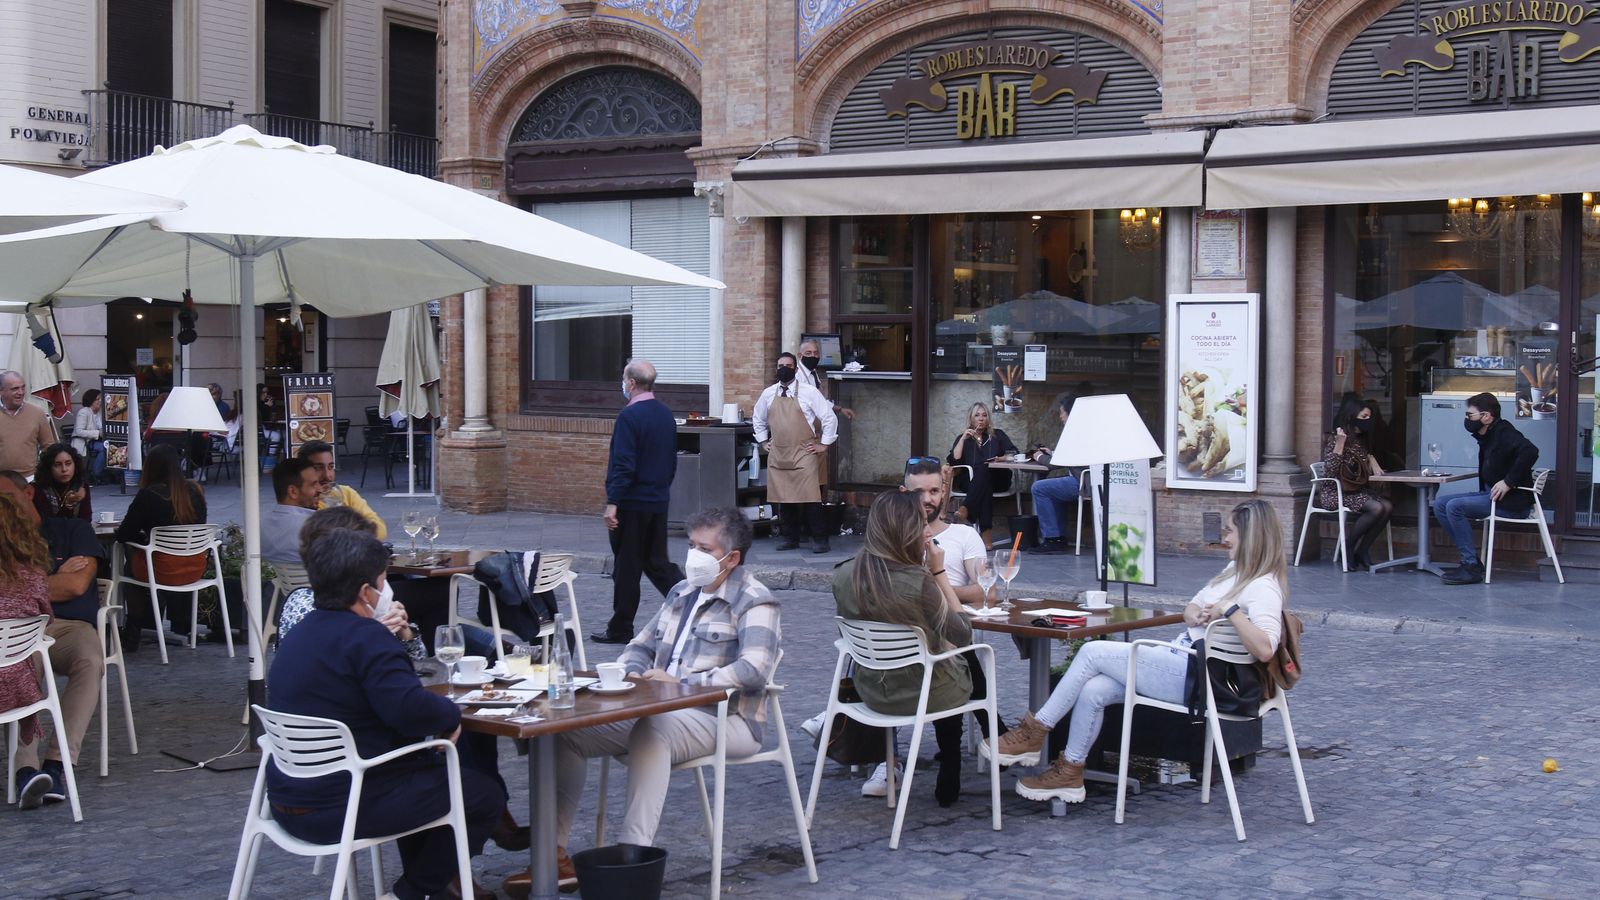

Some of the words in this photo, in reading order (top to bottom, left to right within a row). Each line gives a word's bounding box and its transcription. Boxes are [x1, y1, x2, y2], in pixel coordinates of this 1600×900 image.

[1432, 2, 1501, 36] ROBLES
[1505, 0, 1584, 26] LAREDO
[927, 45, 984, 79] ROBLES
[986, 45, 1049, 69] LAREDO
[1467, 31, 1540, 101] BAR
[956, 73, 1016, 140] BAR
[288, 376, 332, 387] FRITOS
